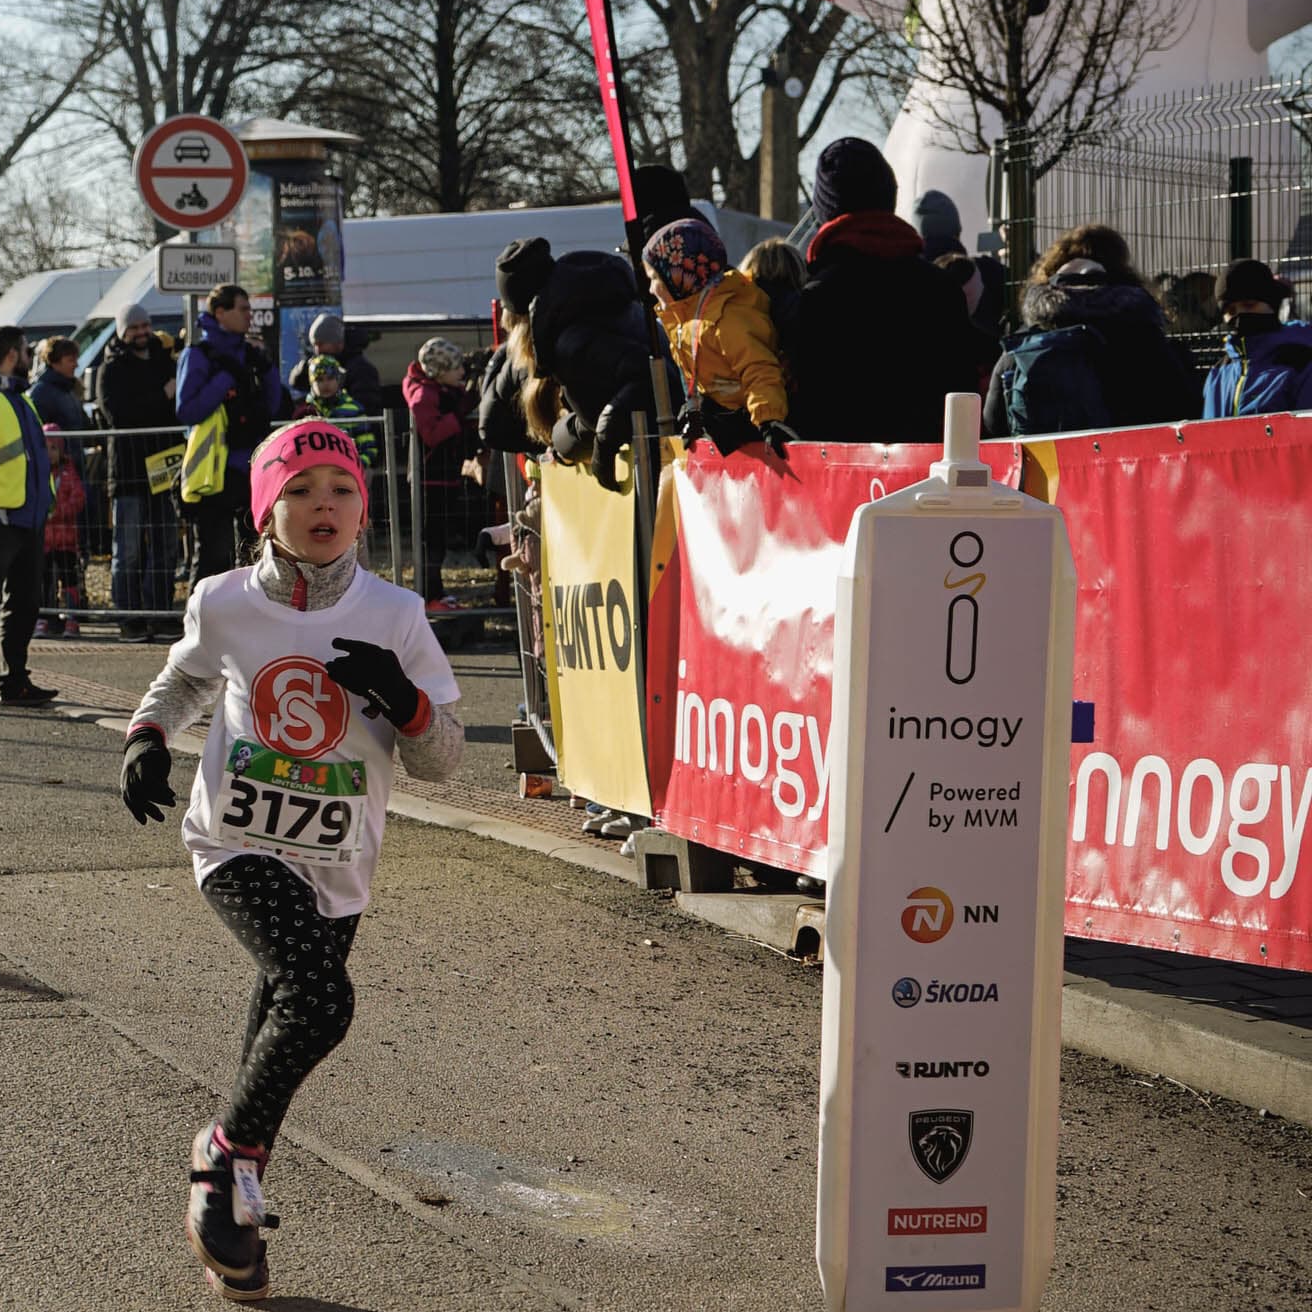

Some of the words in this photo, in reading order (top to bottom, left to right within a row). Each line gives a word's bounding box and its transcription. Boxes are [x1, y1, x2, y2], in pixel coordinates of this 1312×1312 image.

[184, 253, 213, 266] MIMO
[889, 706, 1024, 748] innogy
[675, 659, 831, 821] innogy
[930, 782, 1021, 802] Powered
[222, 779, 352, 845] 3179
[929, 808, 955, 833] by
[964, 809, 1018, 828] MVM
[1072, 752, 1312, 899] nnogy
[963, 905, 999, 924] NN
[924, 980, 999, 1004] ŠKODA
[914, 1061, 990, 1079] RUNTO
[915, 1114, 969, 1124] PEUGEOT
[893, 1212, 983, 1230] NUTREND
